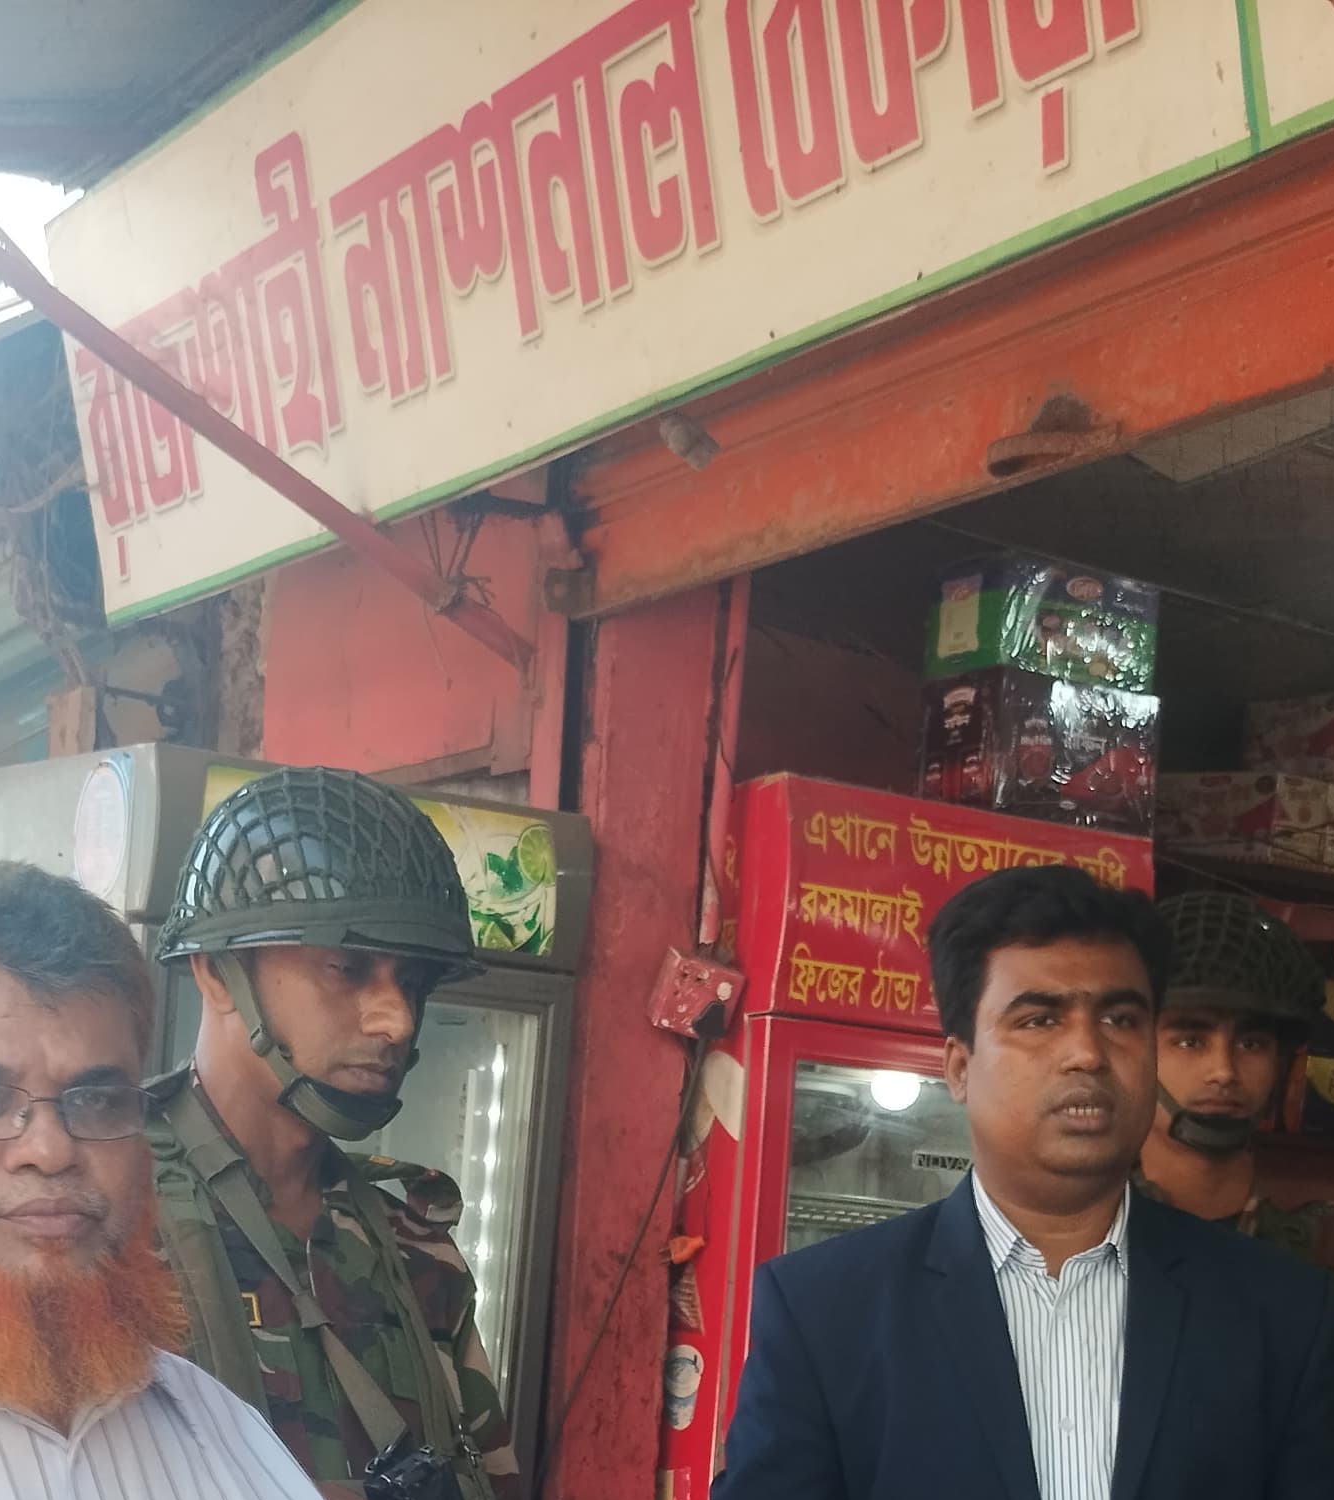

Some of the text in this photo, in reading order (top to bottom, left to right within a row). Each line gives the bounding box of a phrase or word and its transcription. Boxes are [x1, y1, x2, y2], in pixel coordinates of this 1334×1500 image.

[803, 810, 898, 865] এখানে
[907, 813, 1066, 882] উন্নতমা
[788, 942, 866, 1007] ফ্রিজের
